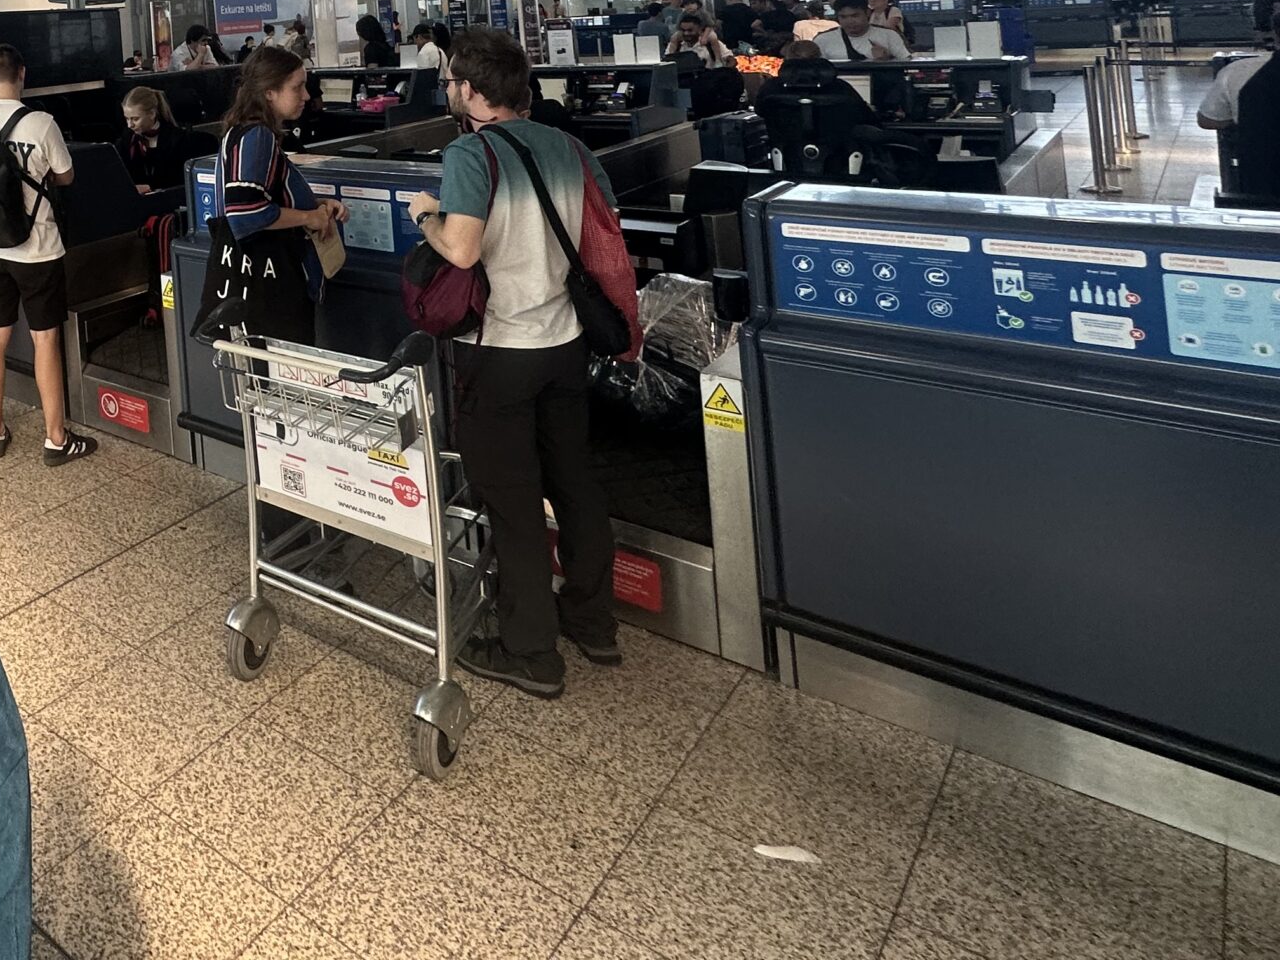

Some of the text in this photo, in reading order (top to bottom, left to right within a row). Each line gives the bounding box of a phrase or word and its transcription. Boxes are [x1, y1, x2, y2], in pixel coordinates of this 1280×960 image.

[338, 440, 368, 454] Prague
[378, 451, 400, 463] TAXI
[394, 481, 418, 495] svez
[353, 487, 367, 497] 222
[368, 492, 377, 500] 111
[378, 496, 394, 506] 000
[337, 500, 386, 521] www.svez.se
